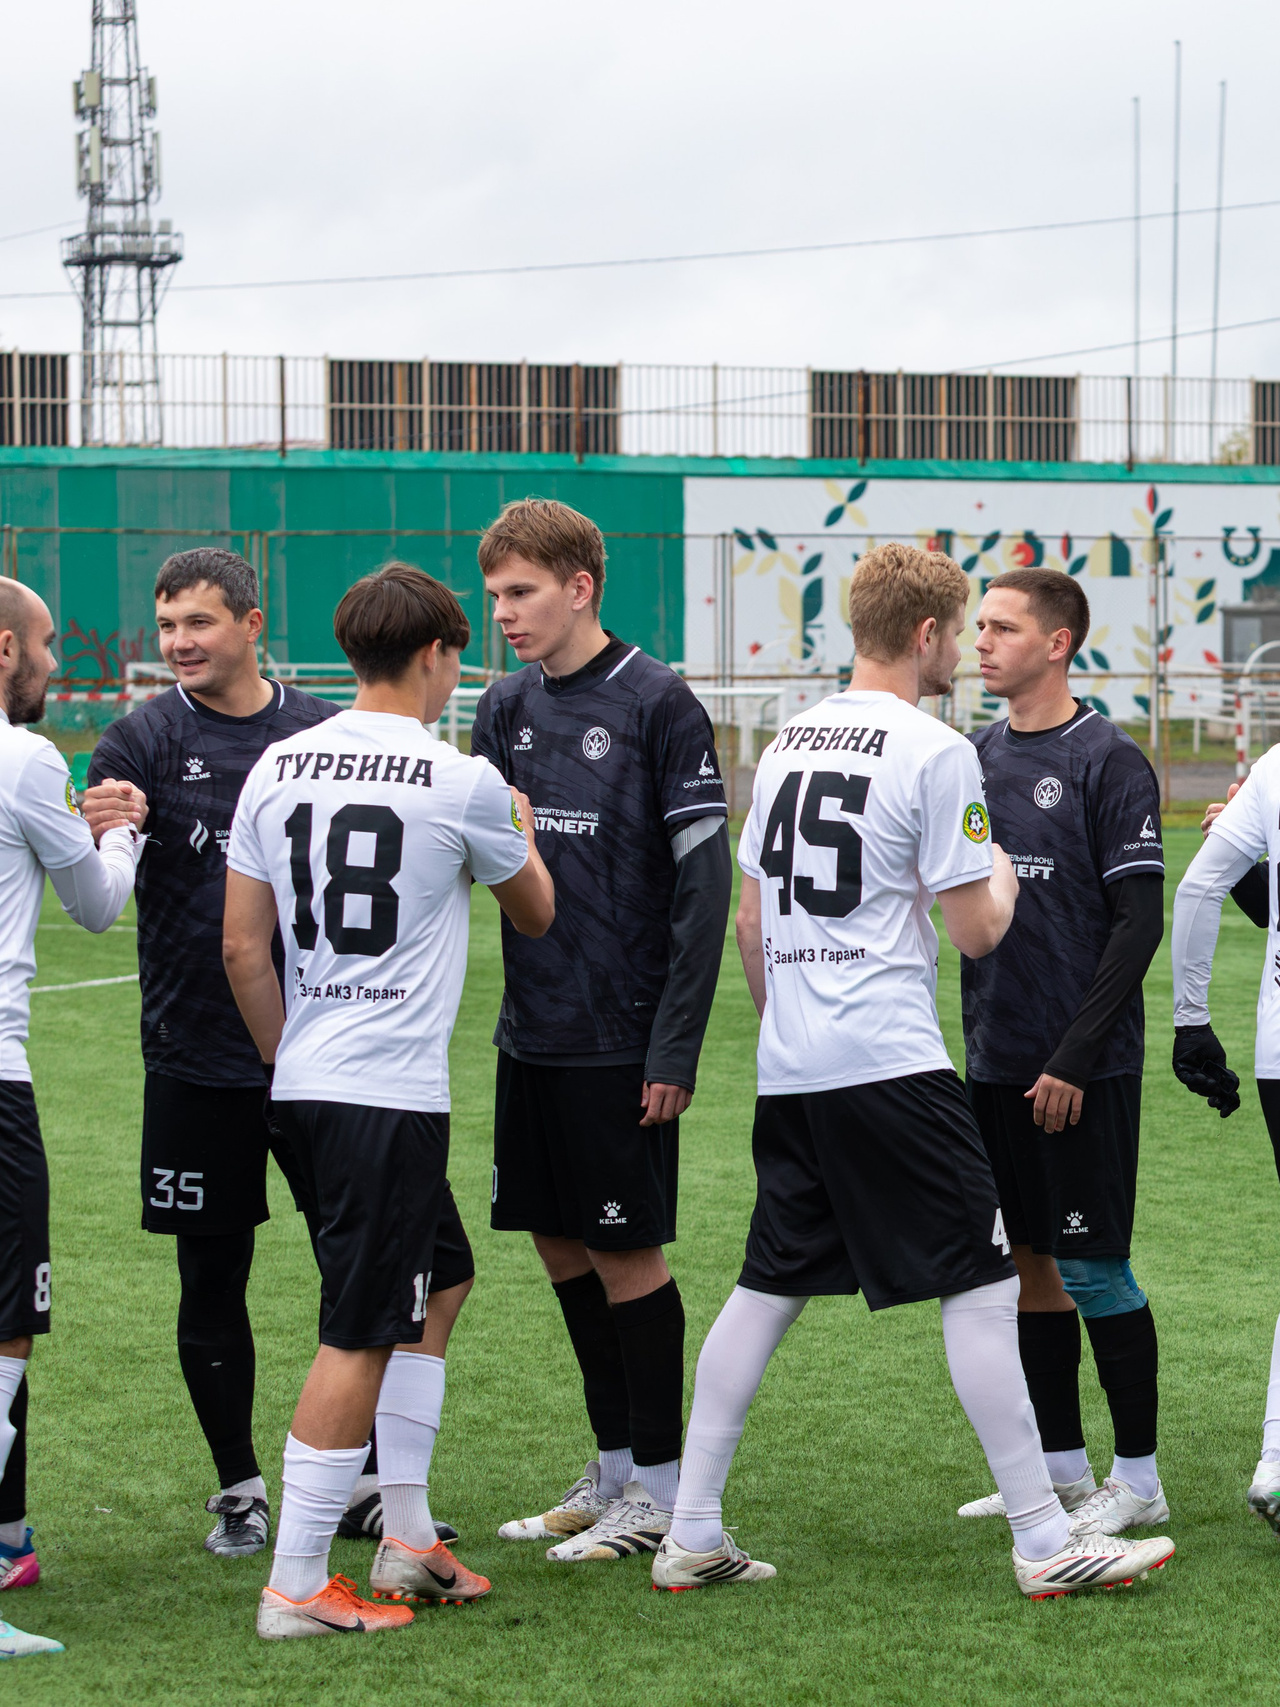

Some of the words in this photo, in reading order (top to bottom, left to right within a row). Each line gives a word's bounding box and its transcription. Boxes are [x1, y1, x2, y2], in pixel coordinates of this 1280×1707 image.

[514, 743, 533, 751] KELM
[774, 726, 888, 757] ТУРБИНА
[183, 772, 211, 781] KELME
[276, 752, 433, 788] ТУРБИНА
[582, 811, 599, 821] ФОНД
[759, 770, 872, 918] 45
[1033, 856, 1054, 866] ФОНД
[284, 802, 405, 957] 18
[821, 948, 866, 965] Гарант
[356, 986, 407, 1003] Гарант
[150, 1167, 204, 1211] 35
[599, 1217, 627, 1225] KELME
[1062, 1226, 1089, 1234] KELME
